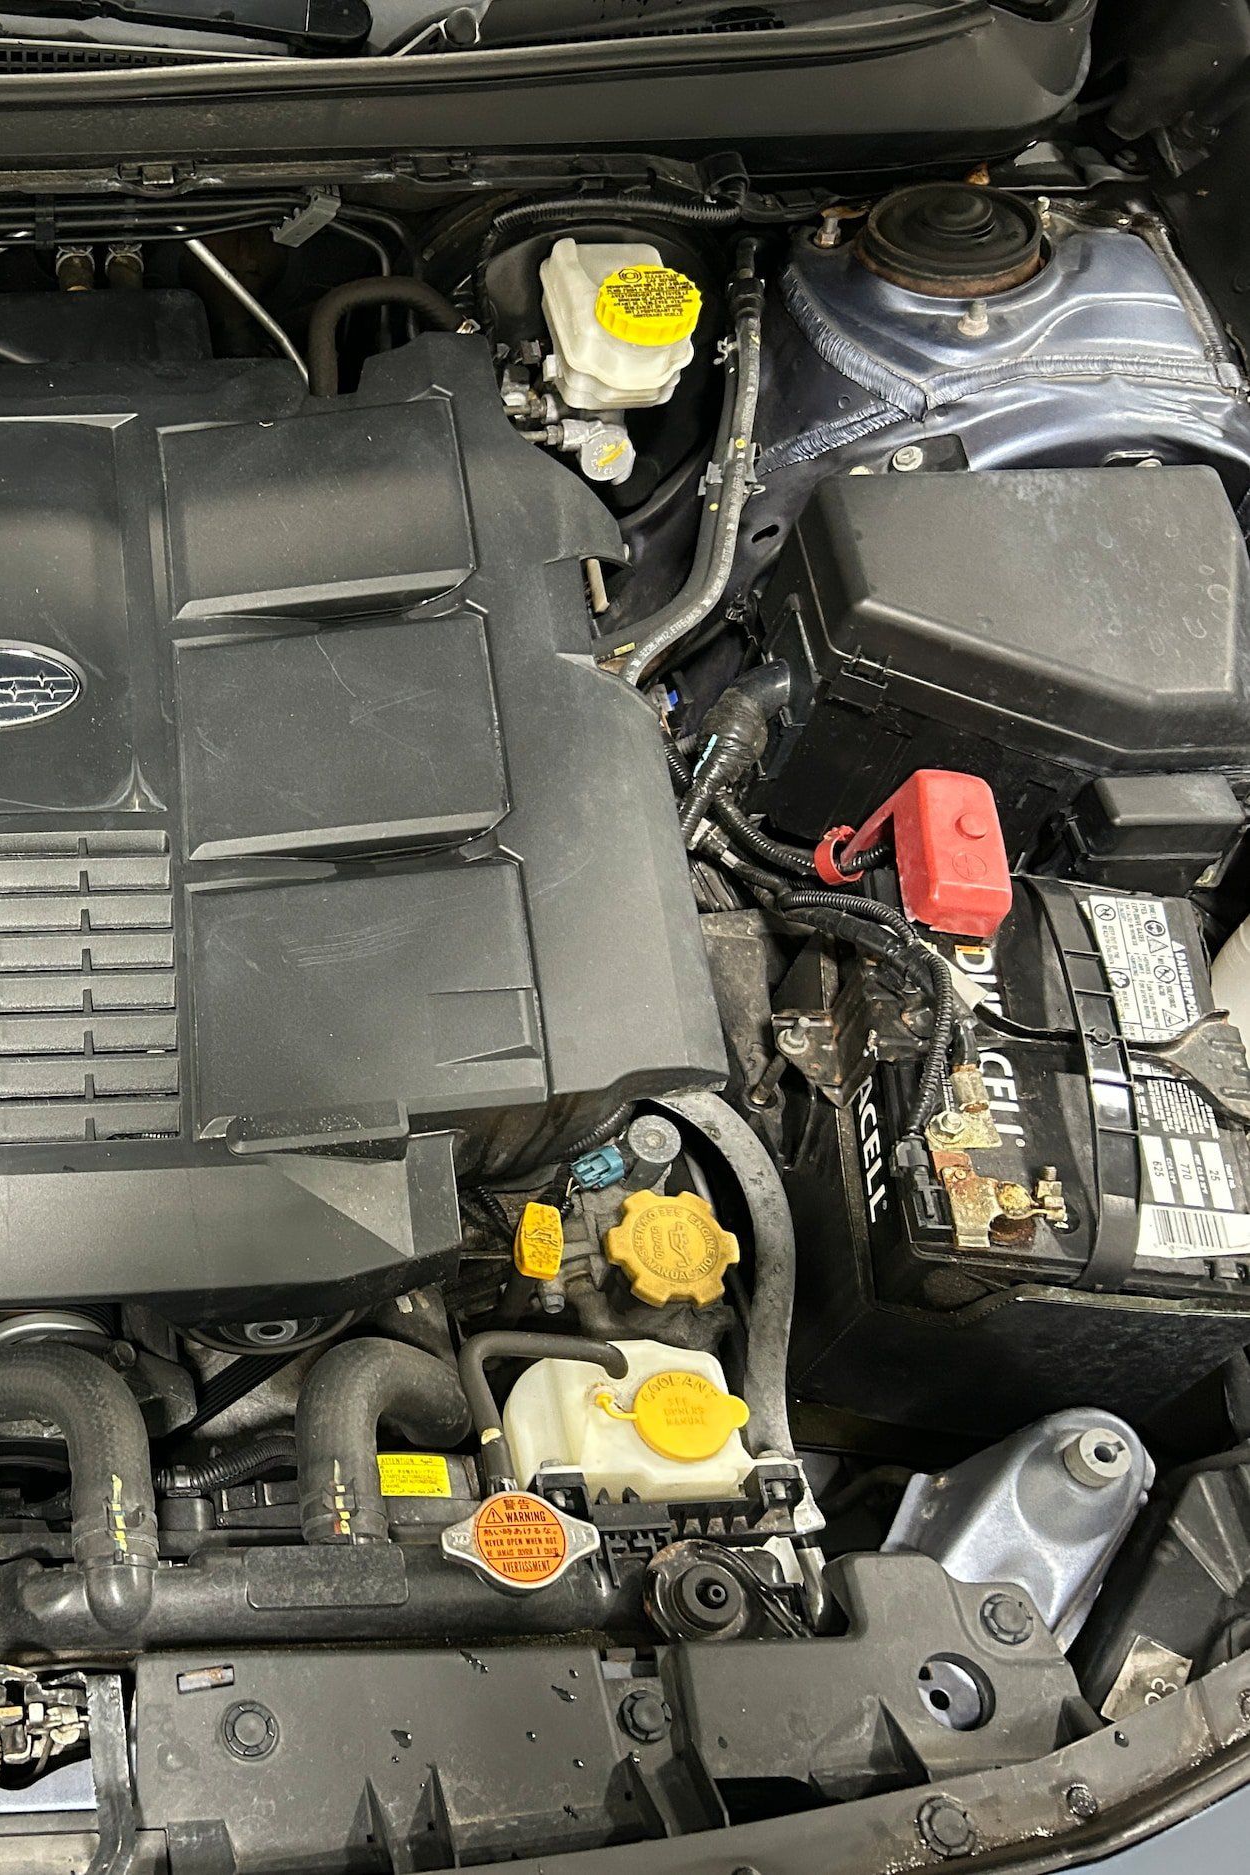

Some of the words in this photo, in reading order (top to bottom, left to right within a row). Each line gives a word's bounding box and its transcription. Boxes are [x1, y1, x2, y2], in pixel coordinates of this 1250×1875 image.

[851, 1076, 886, 1223] ACELL
[1153, 1161, 1164, 1177] 625
[1180, 1164, 1193, 1180] 770
[1210, 1170, 1220, 1181] 25
[658, 1207, 683, 1218] SEE
[688, 1215, 716, 1257] ENGINE
[645, 1258, 693, 1280] MANUAL
[697, 1257, 713, 1274] OIL
[503, 1499, 530, 1510] 警告
[505, 1511, 546, 1522] WARNING
[484, 1538, 504, 1547] NEVER
[507, 1538, 523, 1546] OPEN
[526, 1537, 543, 1546] WHEN
